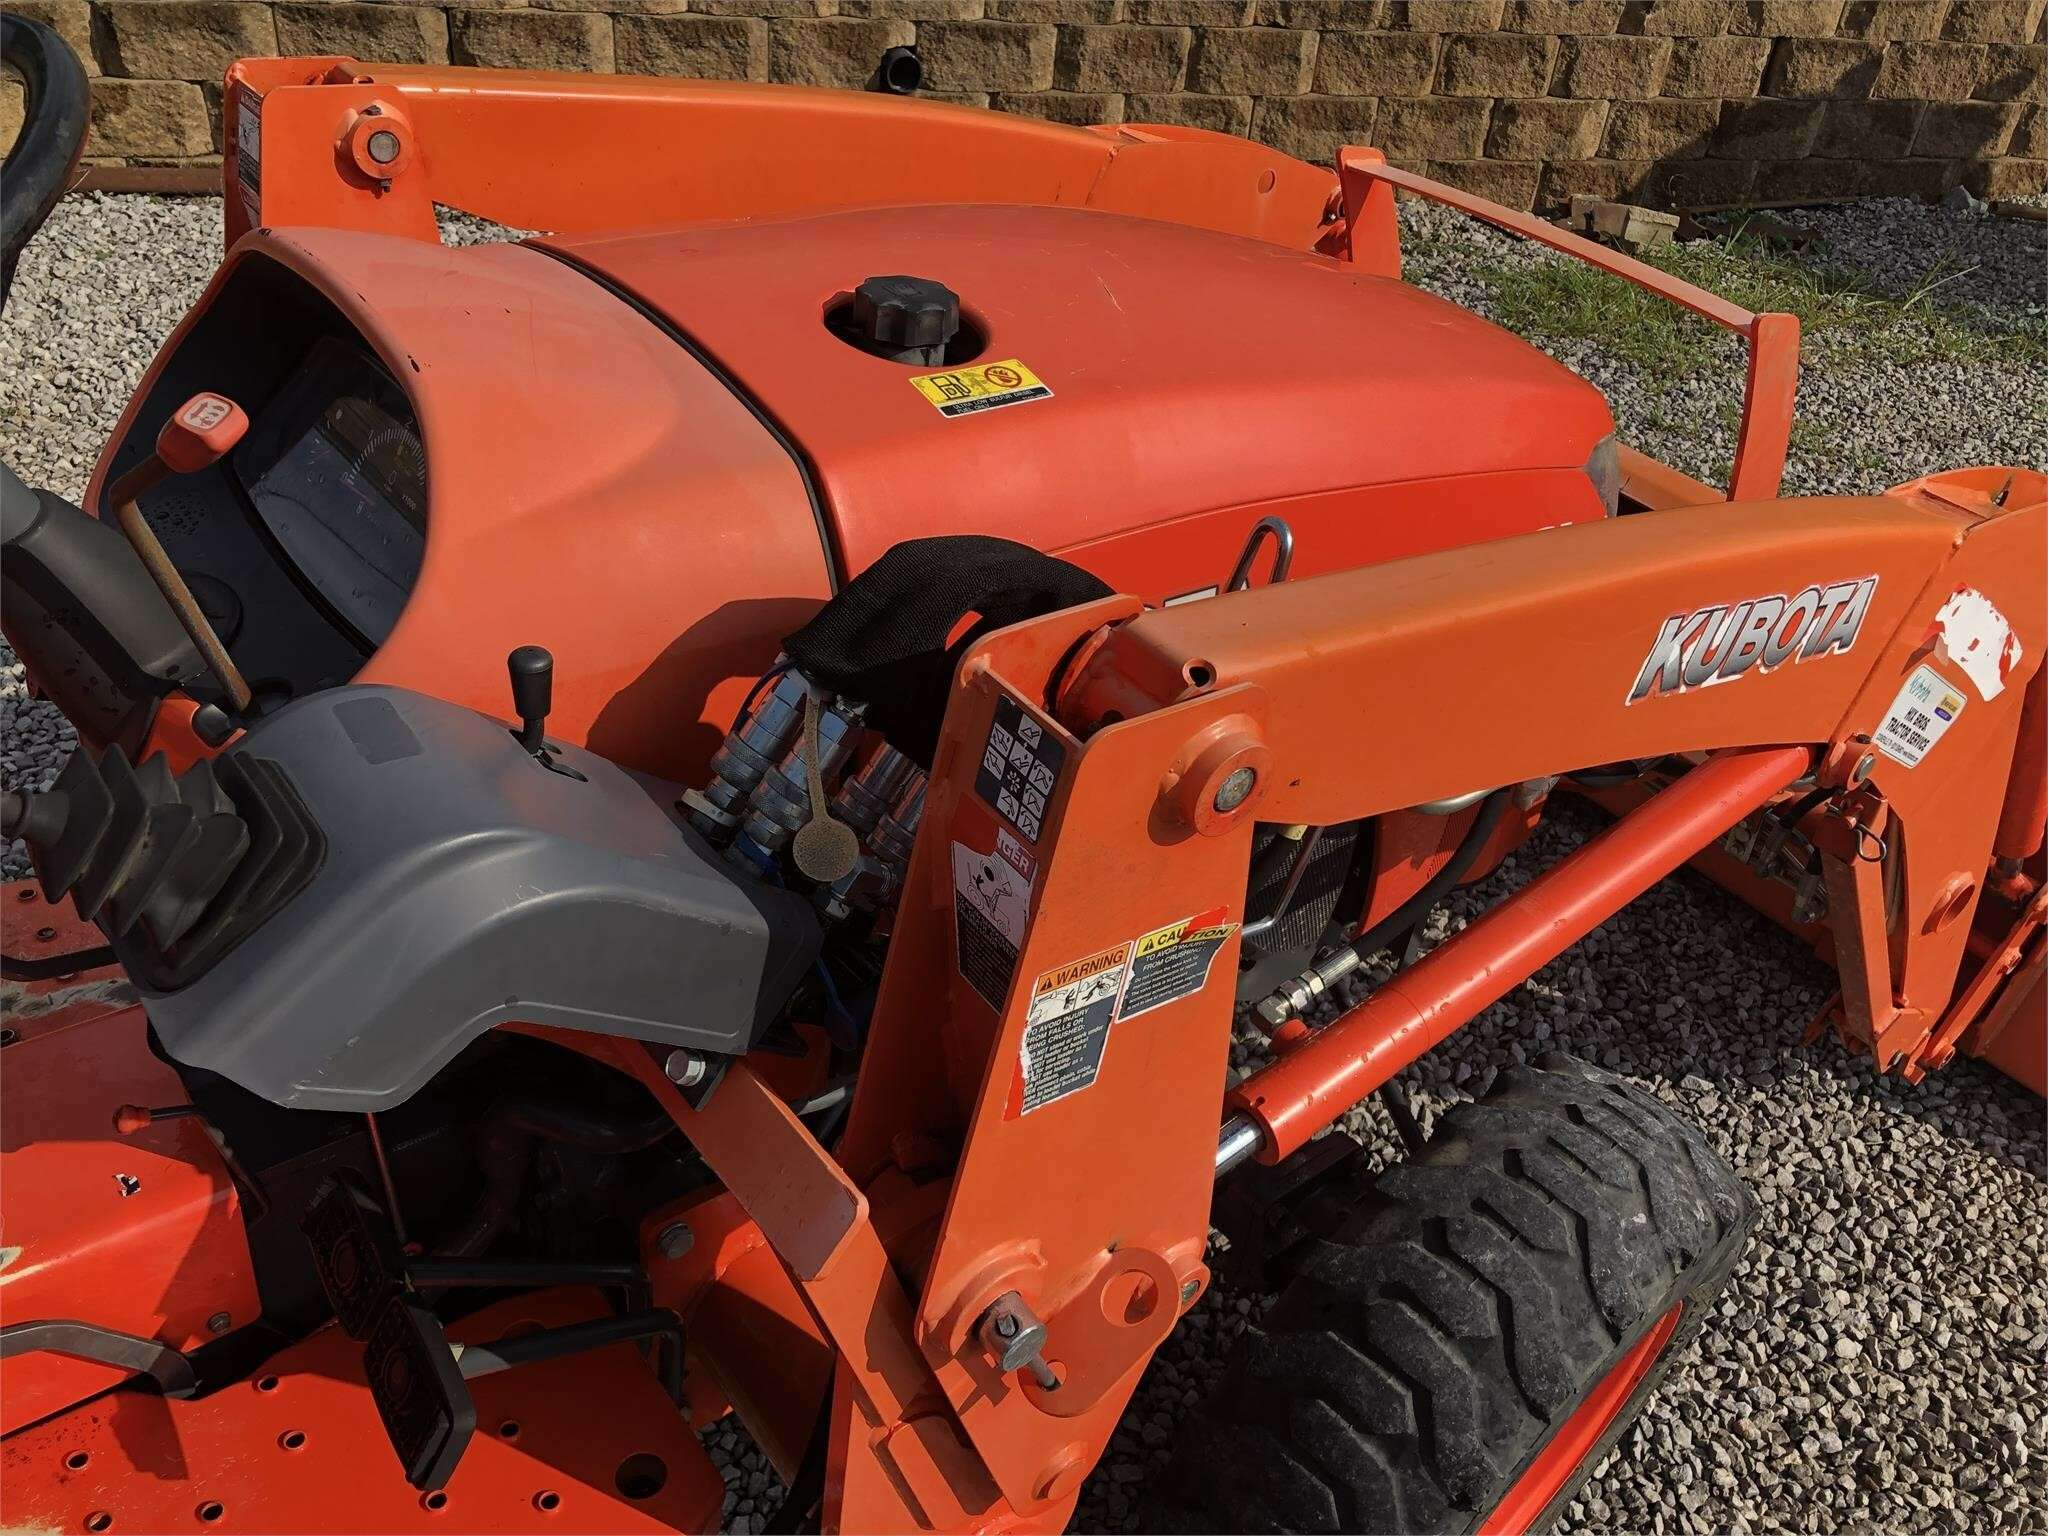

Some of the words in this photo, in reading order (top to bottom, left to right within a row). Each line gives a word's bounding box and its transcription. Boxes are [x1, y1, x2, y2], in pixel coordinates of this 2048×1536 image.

[1628, 577, 1876, 702] KUBOTA
[1885, 716, 1912, 740] TRACTOR
[1906, 731, 1931, 752] SERVICE
[1143, 959, 1164, 972] FROM
[1147, 953, 1155, 962] TO
[1156, 945, 1178, 959] AVOID
[1056, 949, 1125, 985] WARNING
[1039, 1018, 1061, 1032] AVOID
[1062, 1008, 1090, 1024] INJURY
[1048, 1022, 1071, 1037] FALLS
[1072, 1017, 1084, 1027] OR
